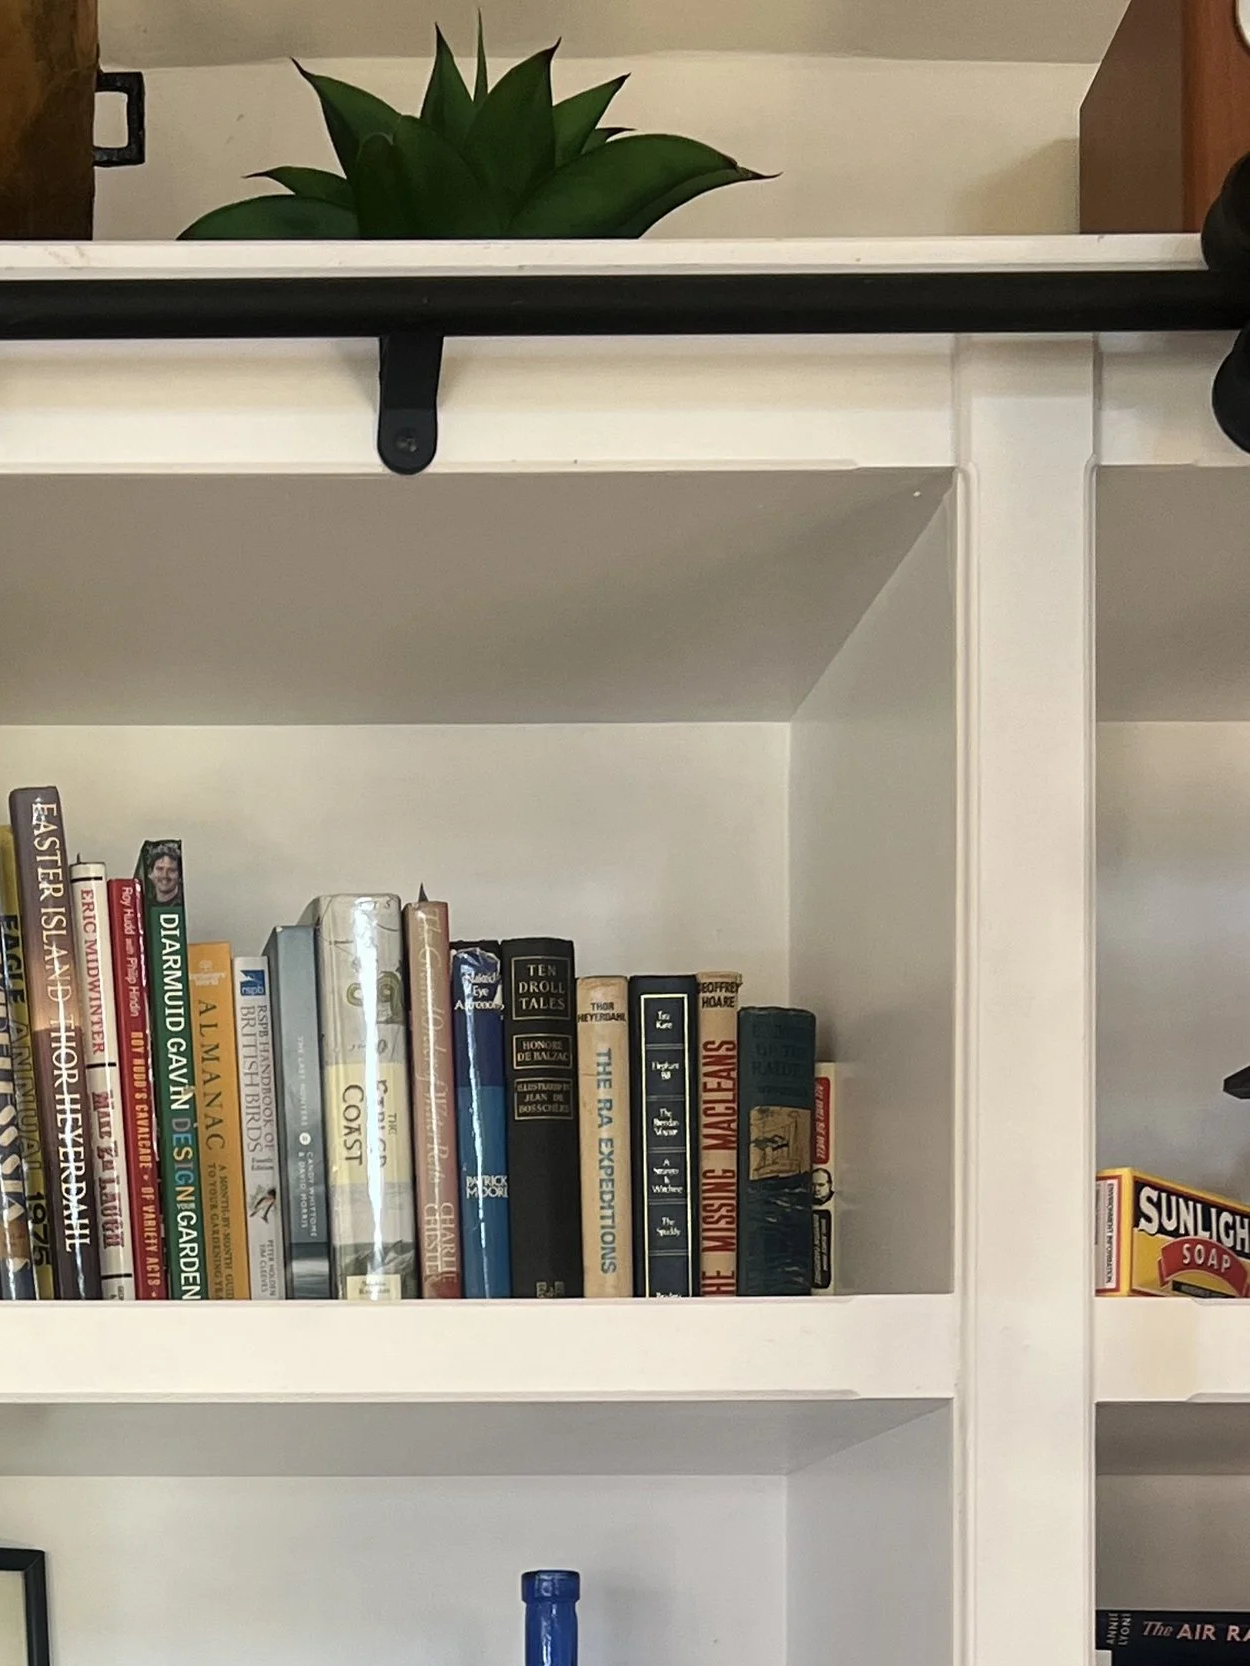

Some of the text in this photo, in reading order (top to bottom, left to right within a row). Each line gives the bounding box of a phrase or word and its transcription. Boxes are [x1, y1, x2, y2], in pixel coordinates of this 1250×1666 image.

[120, 886, 133, 907] Roy
[123, 909, 136, 935] Hudd
[80, 889, 105, 1056] ERIC MIDWINTER
[126, 957, 138, 983] Philip
[527, 963, 557, 977] TEN
[129, 986, 141, 1017] Hindin
[241, 983, 265, 996] rspb
[472, 985, 490, 998] Eye
[518, 981, 565, 994] DROLL
[701, 996, 736, 1009] HOARE
[160, 913, 190, 1111] DIARMUID GAVIN
[519, 997, 566, 1010] TALES
[577, 1012, 627, 1023] HEYERDAHL
[590, 1002, 615, 1012] THOR
[32, 801, 91, 1253] EASTER ISLAND THOR HEYERDAHL
[256, 1004, 269, 1039] RSPB
[130, 1031, 144, 1055] ROY
[517, 1051, 569, 1062] DE BALZAC
[0, 914, 51, 1266] EAGLE ANNUAL 1975
[198, 999, 226, 1151] ALMANAC
[240, 1005, 262, 1153] BRITISH BIRDS
[258, 1041, 275, 1129] HANDBOOK
[702, 1039, 738, 1151] MACLEANS
[135, 1102, 153, 1169] CAVALCADE
[342, 1084, 365, 1166] COAST
[207, 1163, 217, 1178] TO
[218, 1164, 227, 1172] A
[596, 1047, 617, 1275] THE RA EXPEDITIONS
[141, 1186, 155, 1201] OF
[466, 1175, 508, 1186] PATRICK
[171, 1116, 201, 1300] DESIGN GARDEN
[208, 1181, 219, 1211] YOUR
[701, 1168, 737, 1253] MISSING
[142, 1204, 158, 1257] VARIETY
[1138, 1185, 1250, 1253] SUNLIGH
[210, 1213, 222, 1278] GARDENING
[440, 1202, 457, 1284] CHARLIE
[146, 1259, 161, 1287] ACTS
[1182, 1243, 1231, 1274] SOAP
[1142, 1620, 1174, 1637] The
[1176, 1623, 1217, 1641] AIR
